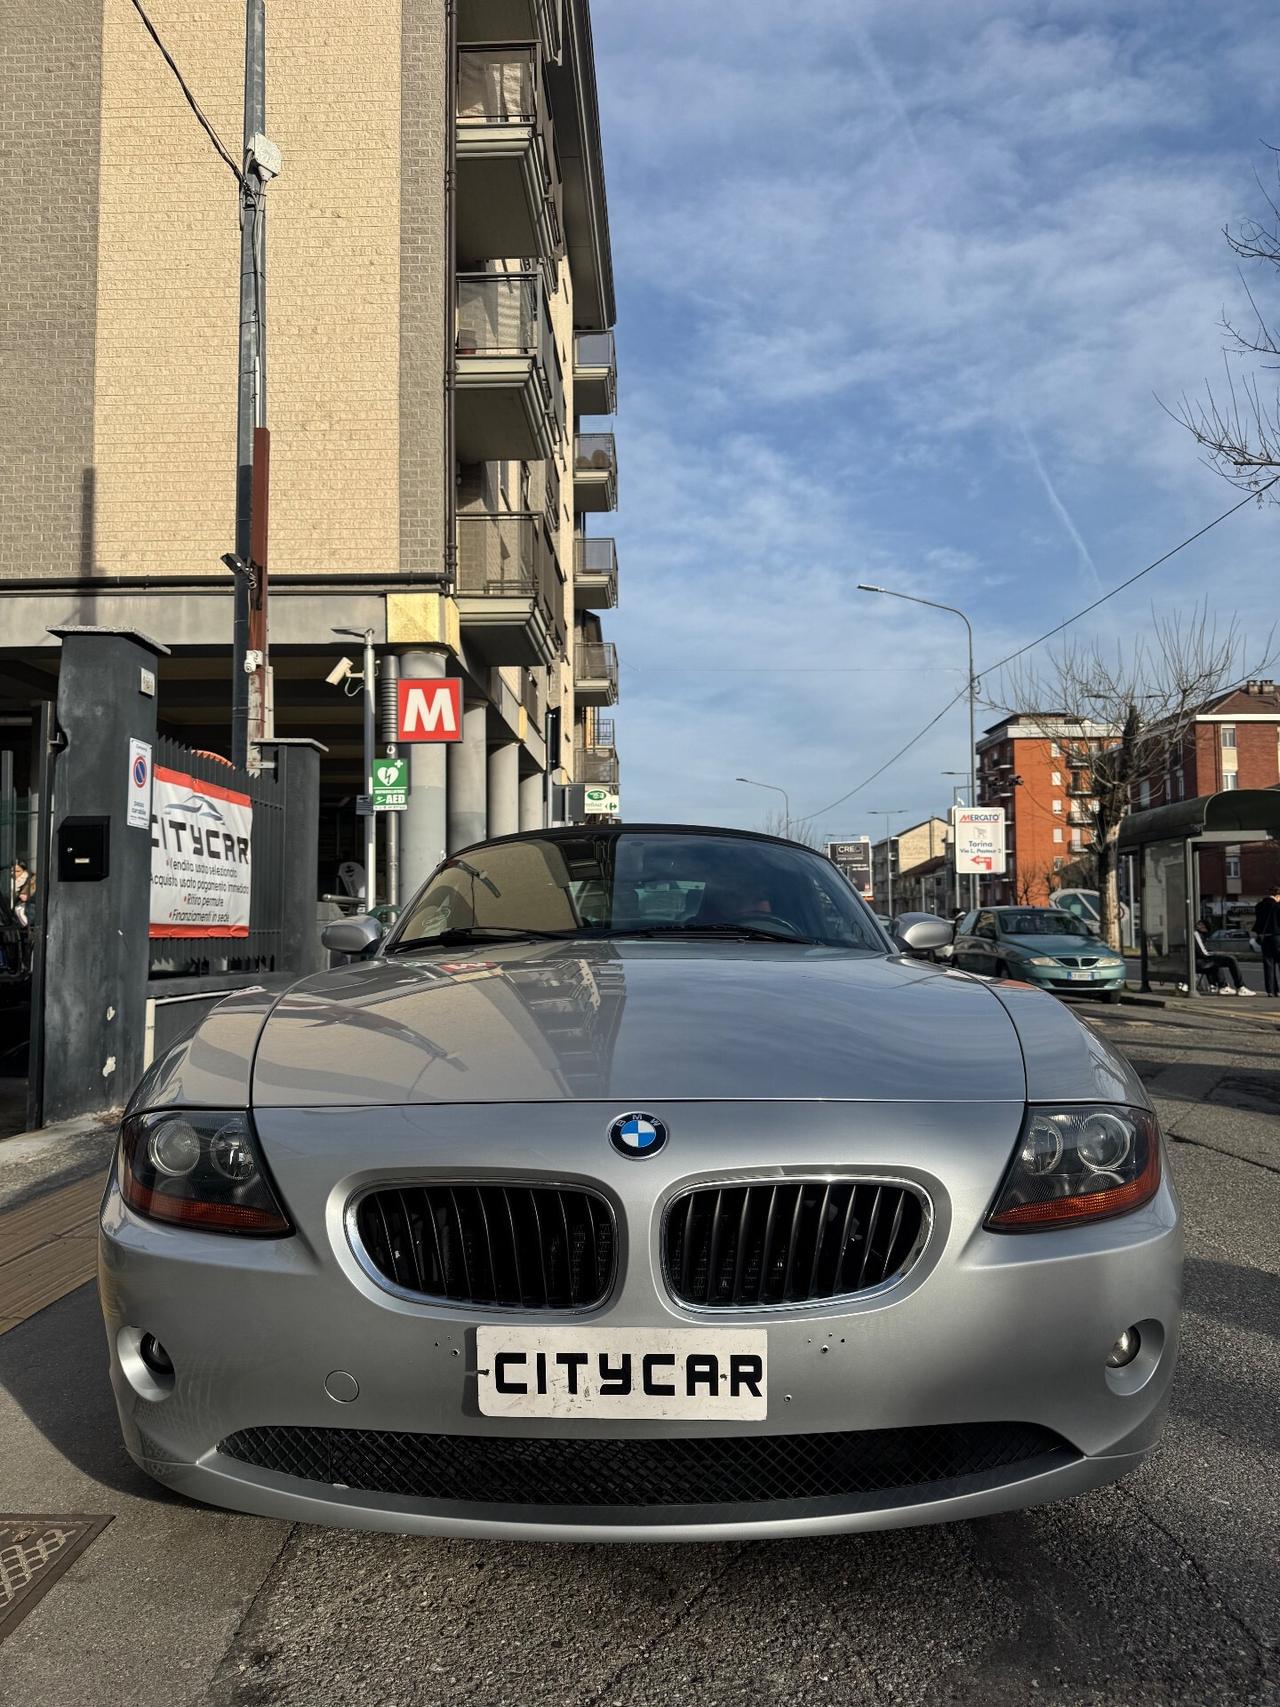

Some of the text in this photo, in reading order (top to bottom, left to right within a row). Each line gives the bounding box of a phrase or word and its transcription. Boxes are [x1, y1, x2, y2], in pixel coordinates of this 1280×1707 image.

[403, 688, 457, 732] M
[385, 794, 406, 804] AED
[960, 814, 999, 822] MERCATO
[968, 840, 992, 848] Torino
[179, 876, 197, 889] usato
[615, 1114, 661, 1126] BMW
[495, 1352, 763, 1397] CITYCAR
